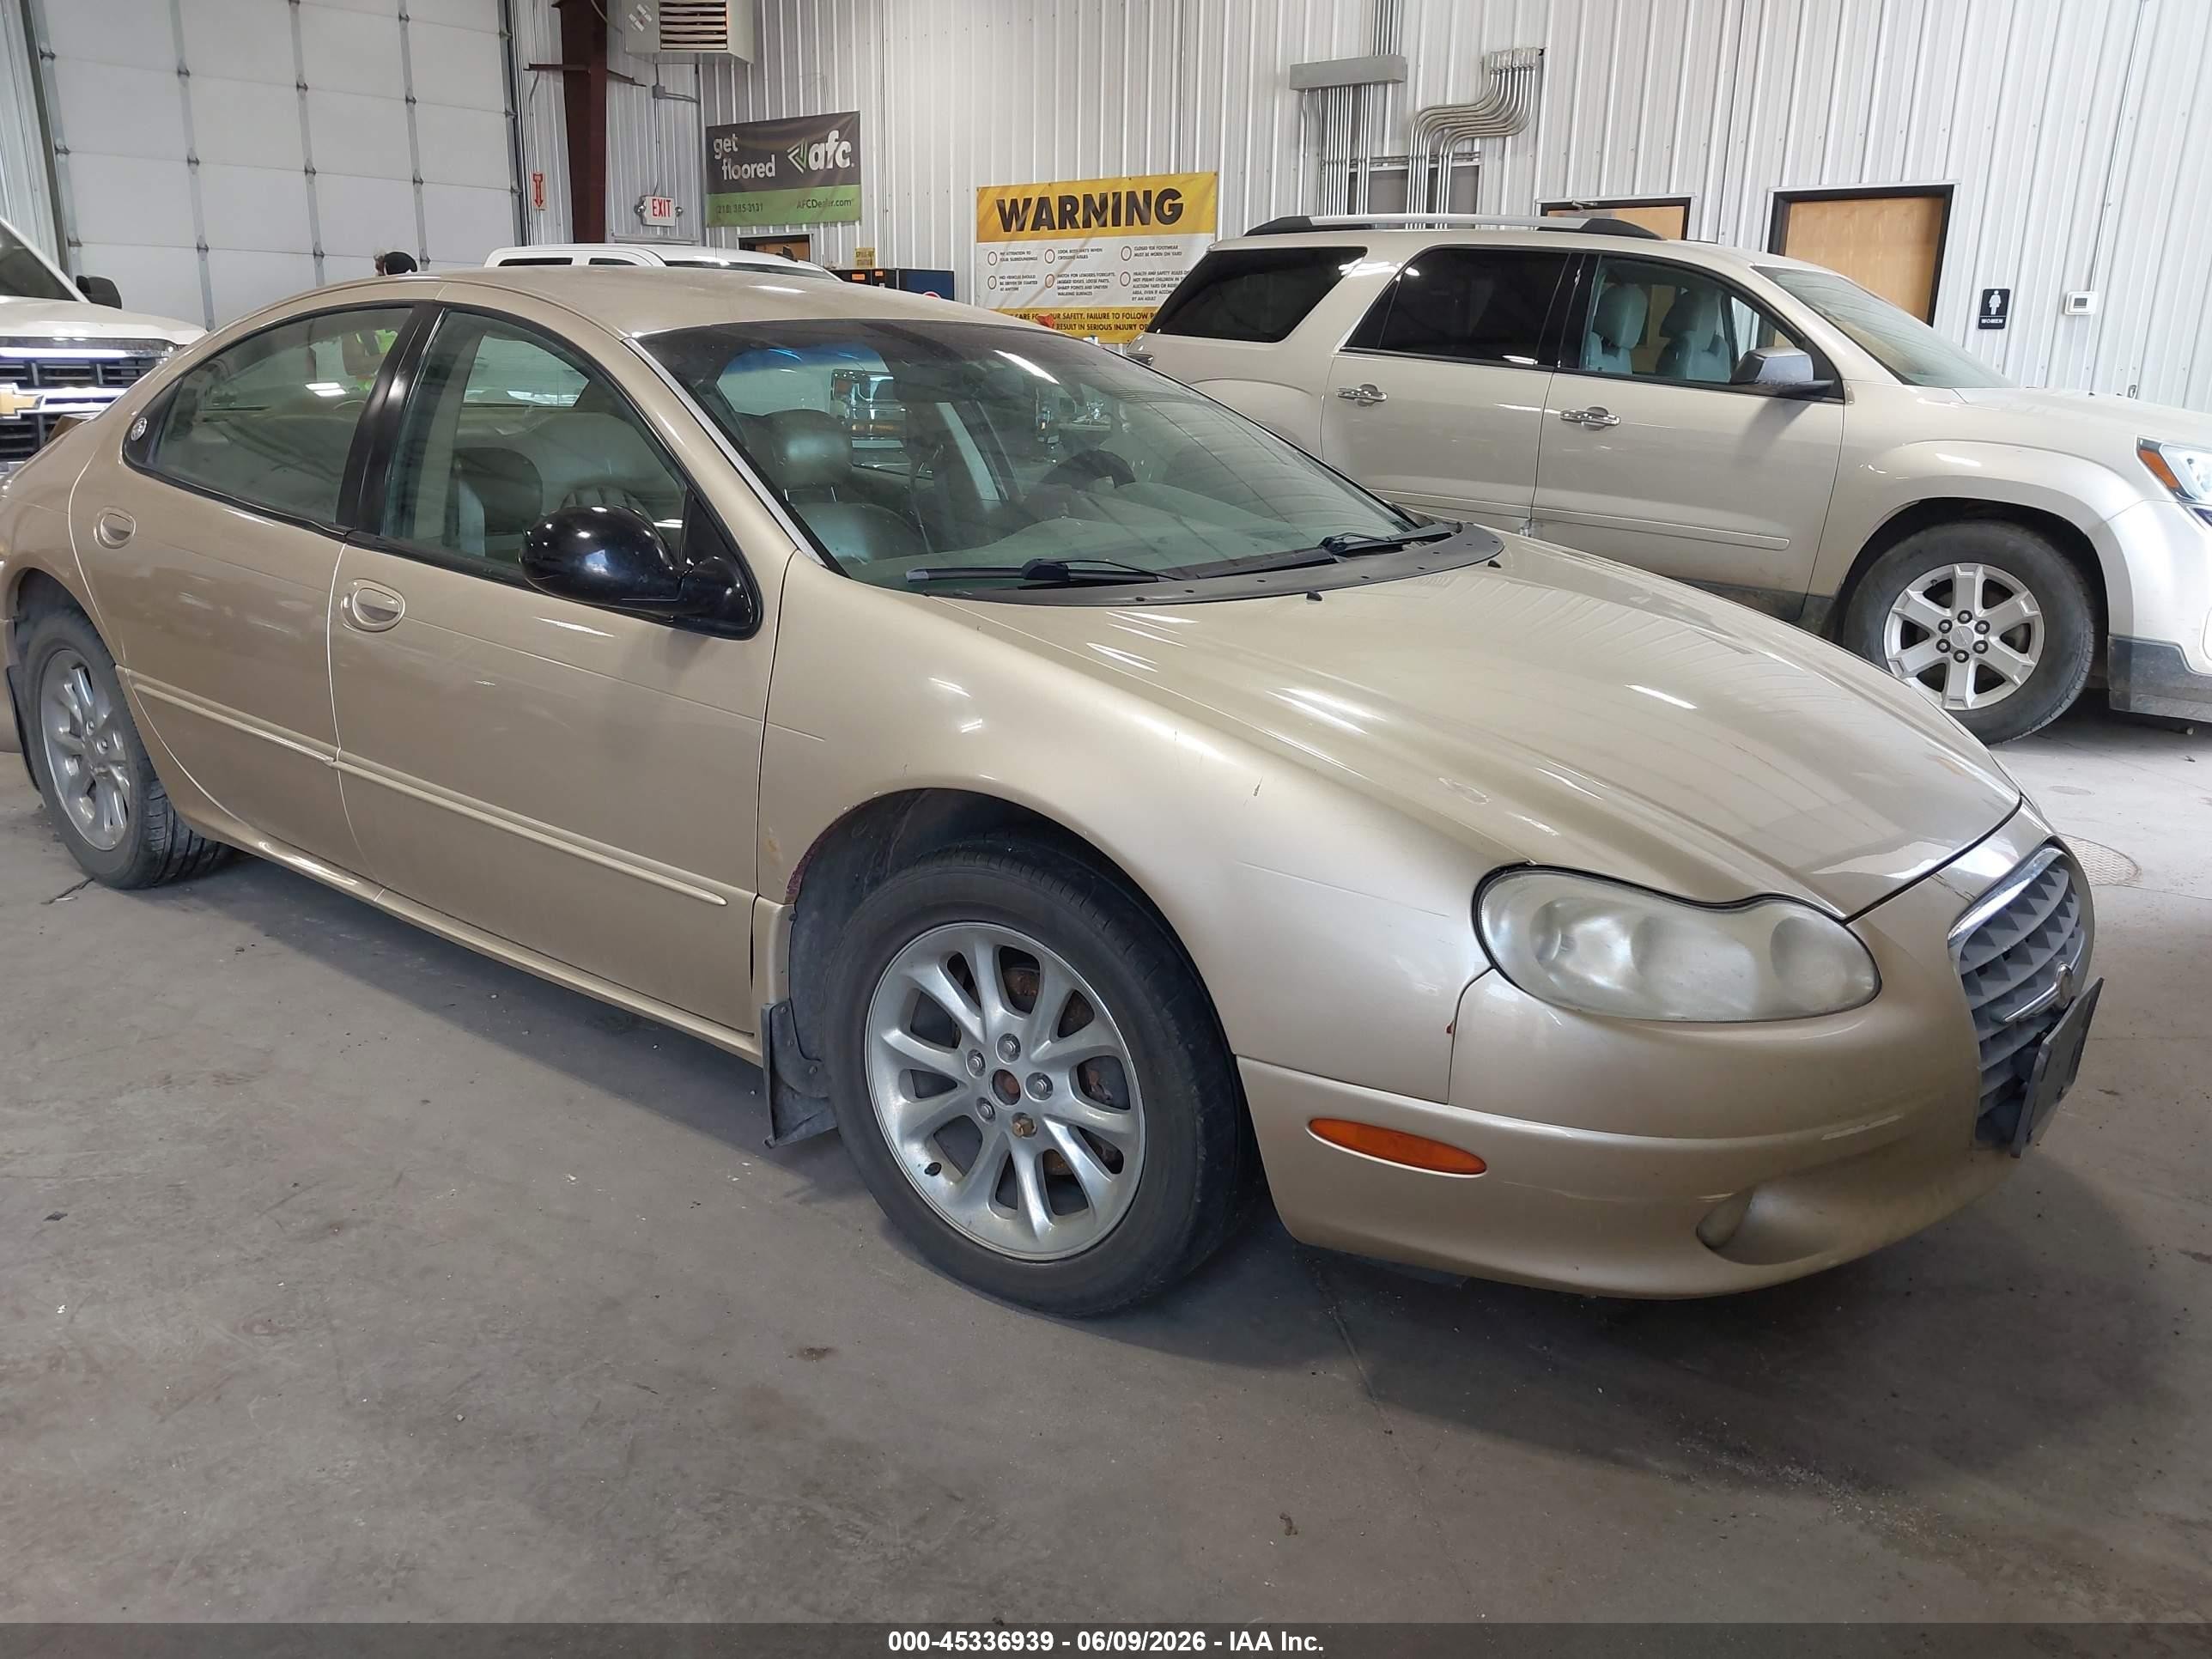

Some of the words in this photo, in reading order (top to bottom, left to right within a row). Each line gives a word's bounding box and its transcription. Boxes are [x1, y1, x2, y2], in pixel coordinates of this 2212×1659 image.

[714, 133, 738, 160] get
[808, 130, 852, 171] afc
[721, 154, 776, 180] floored
[652, 198, 672, 218] EXIT
[995, 187, 1184, 233] WARNING
[1062, 312, 1085, 320] SAFETY.
